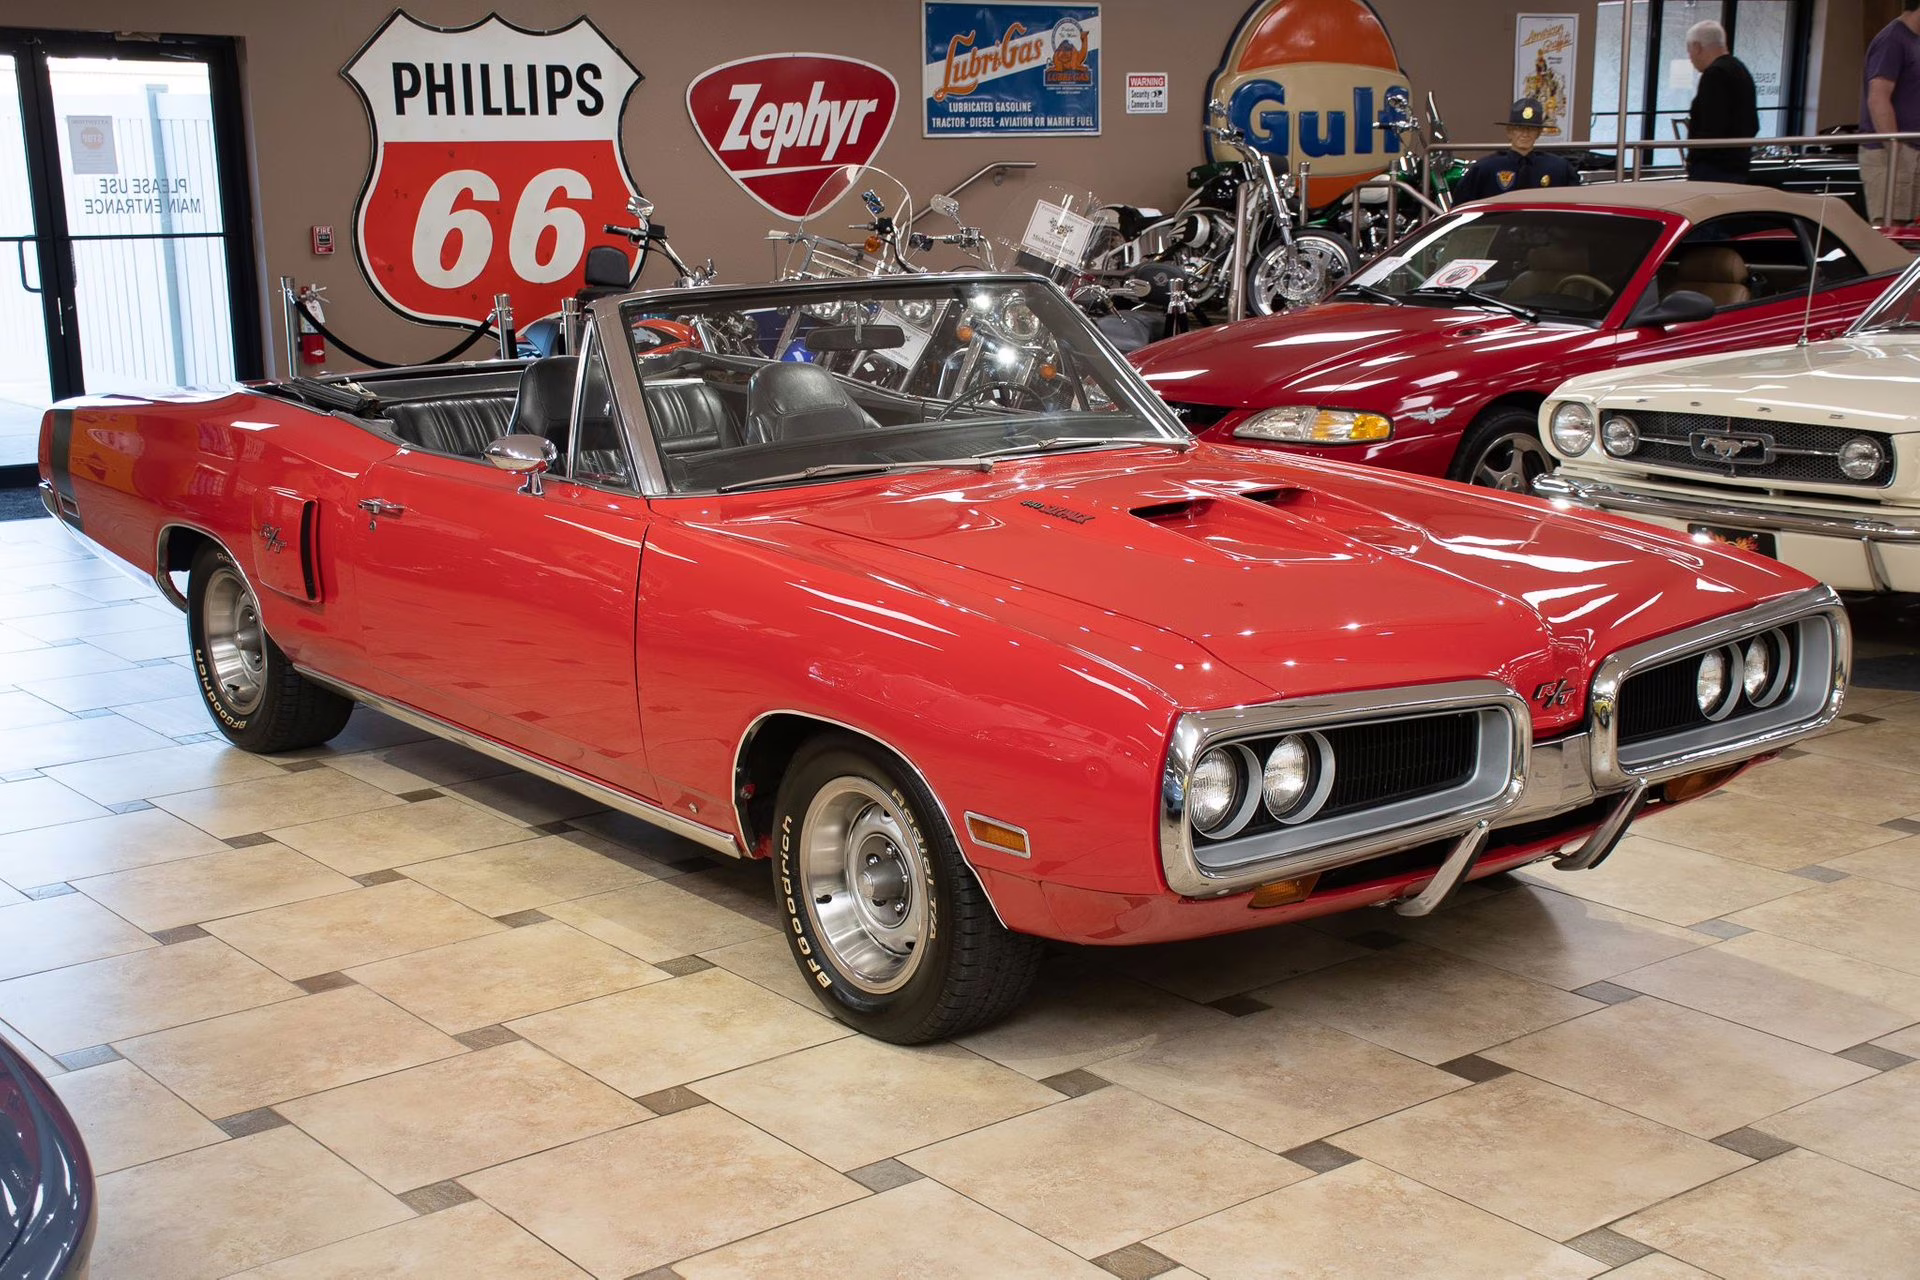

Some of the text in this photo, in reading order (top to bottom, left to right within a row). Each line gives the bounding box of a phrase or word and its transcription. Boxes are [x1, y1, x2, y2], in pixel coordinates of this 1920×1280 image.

[391, 62, 605, 117] PHILLIPS
[1129, 77, 1164, 87] WARNING
[1131, 90, 1150, 100] Security
[949, 101, 1032, 113] LUBRICATED GASOLINE
[1131, 100, 1150, 109] Cameras
[1228, 78, 1410, 158] Gulf
[719, 80, 879, 164] Zephyr
[1034, 117, 1046, 127] OR
[1047, 117, 1076, 127] MARINE
[1076, 117, 1094, 127] FUEL
[315, 226, 332, 235] FIRE
[411, 167, 594, 290] 66
[260, 522, 288, 554] R/T
[195, 649, 248, 729] BFGoodrich
[1532, 678, 1577, 709] R/T
[891, 788, 938, 940] Radial T/A
[781, 814, 833, 989] BFGoodrich
